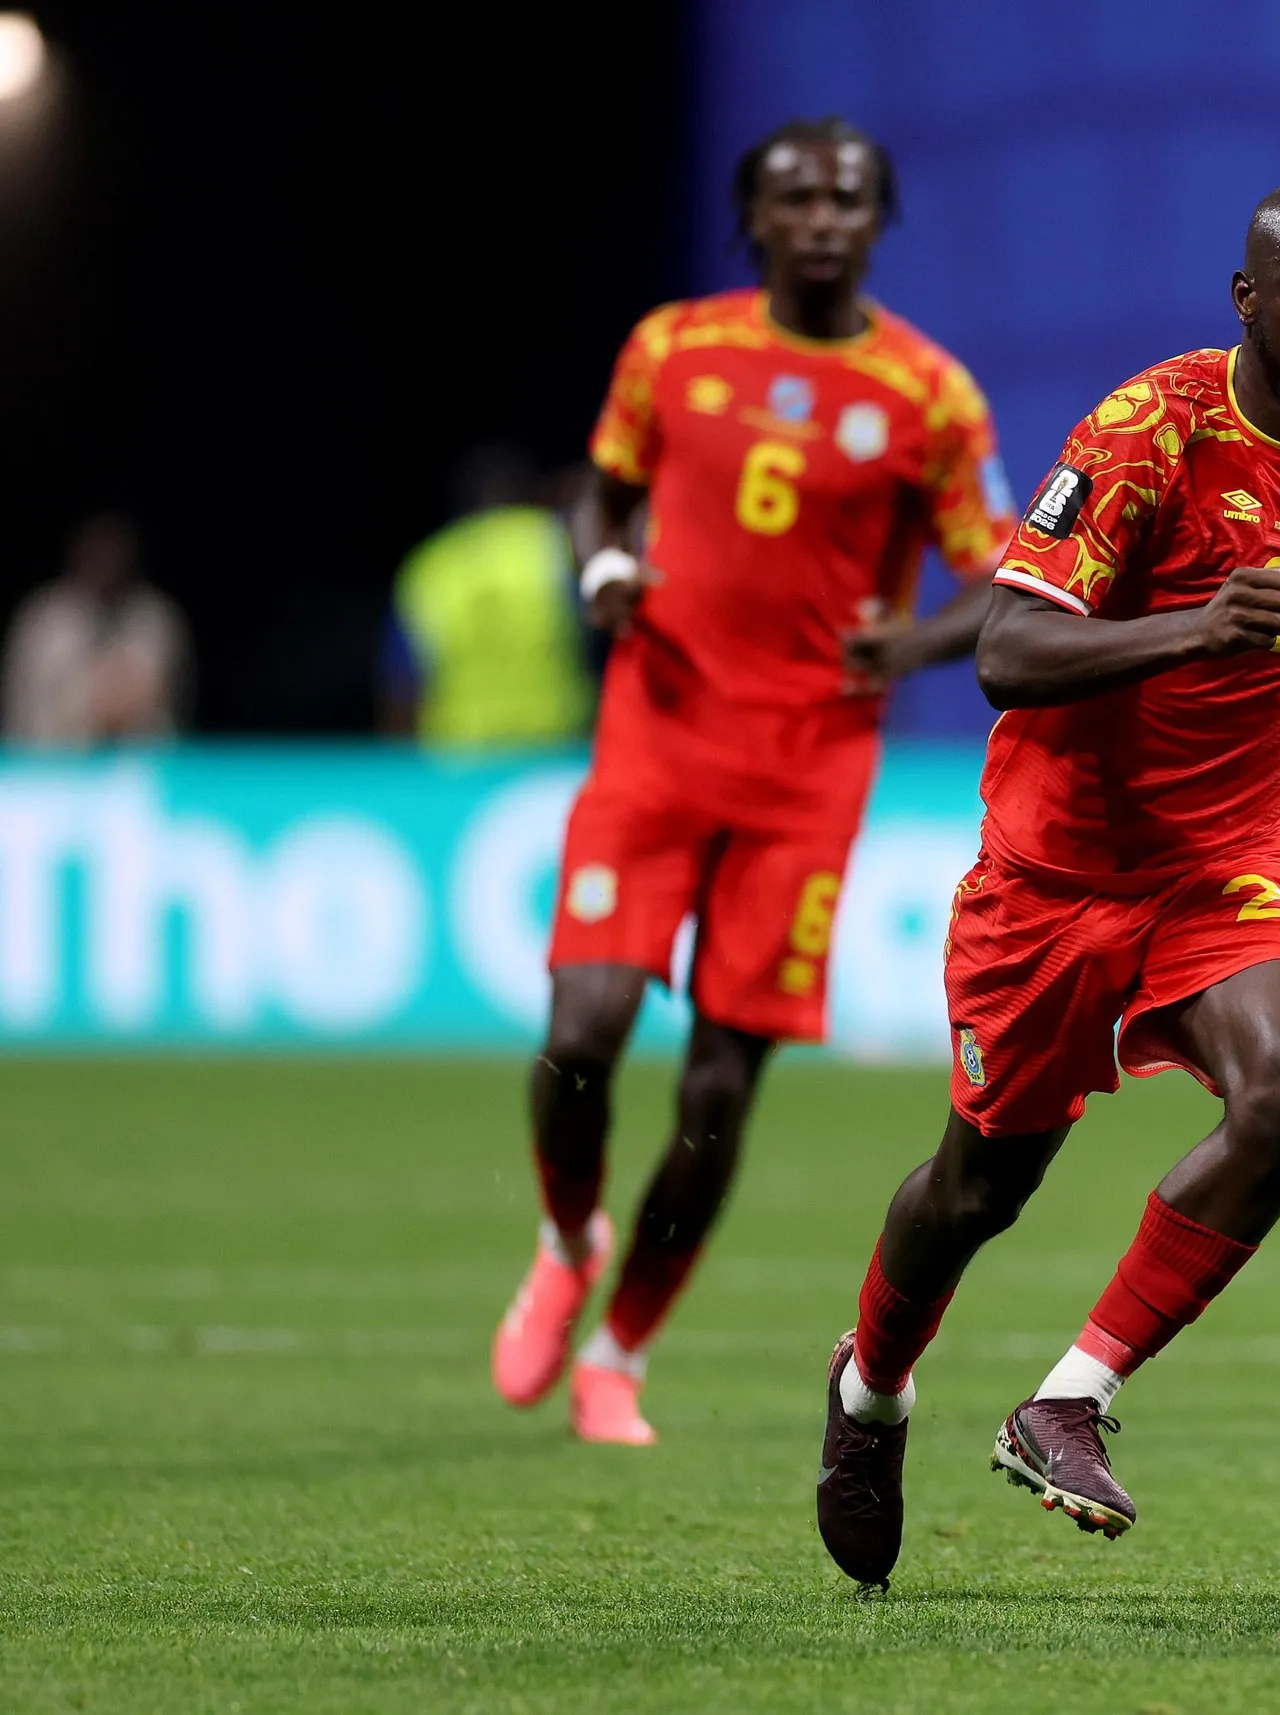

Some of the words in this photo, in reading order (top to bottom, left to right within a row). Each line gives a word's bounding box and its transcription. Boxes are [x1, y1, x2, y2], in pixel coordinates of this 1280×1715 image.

[737, 441, 806, 536] 6
[1223, 509, 1261, 524] umbro
[791, 872, 840, 957] 6
